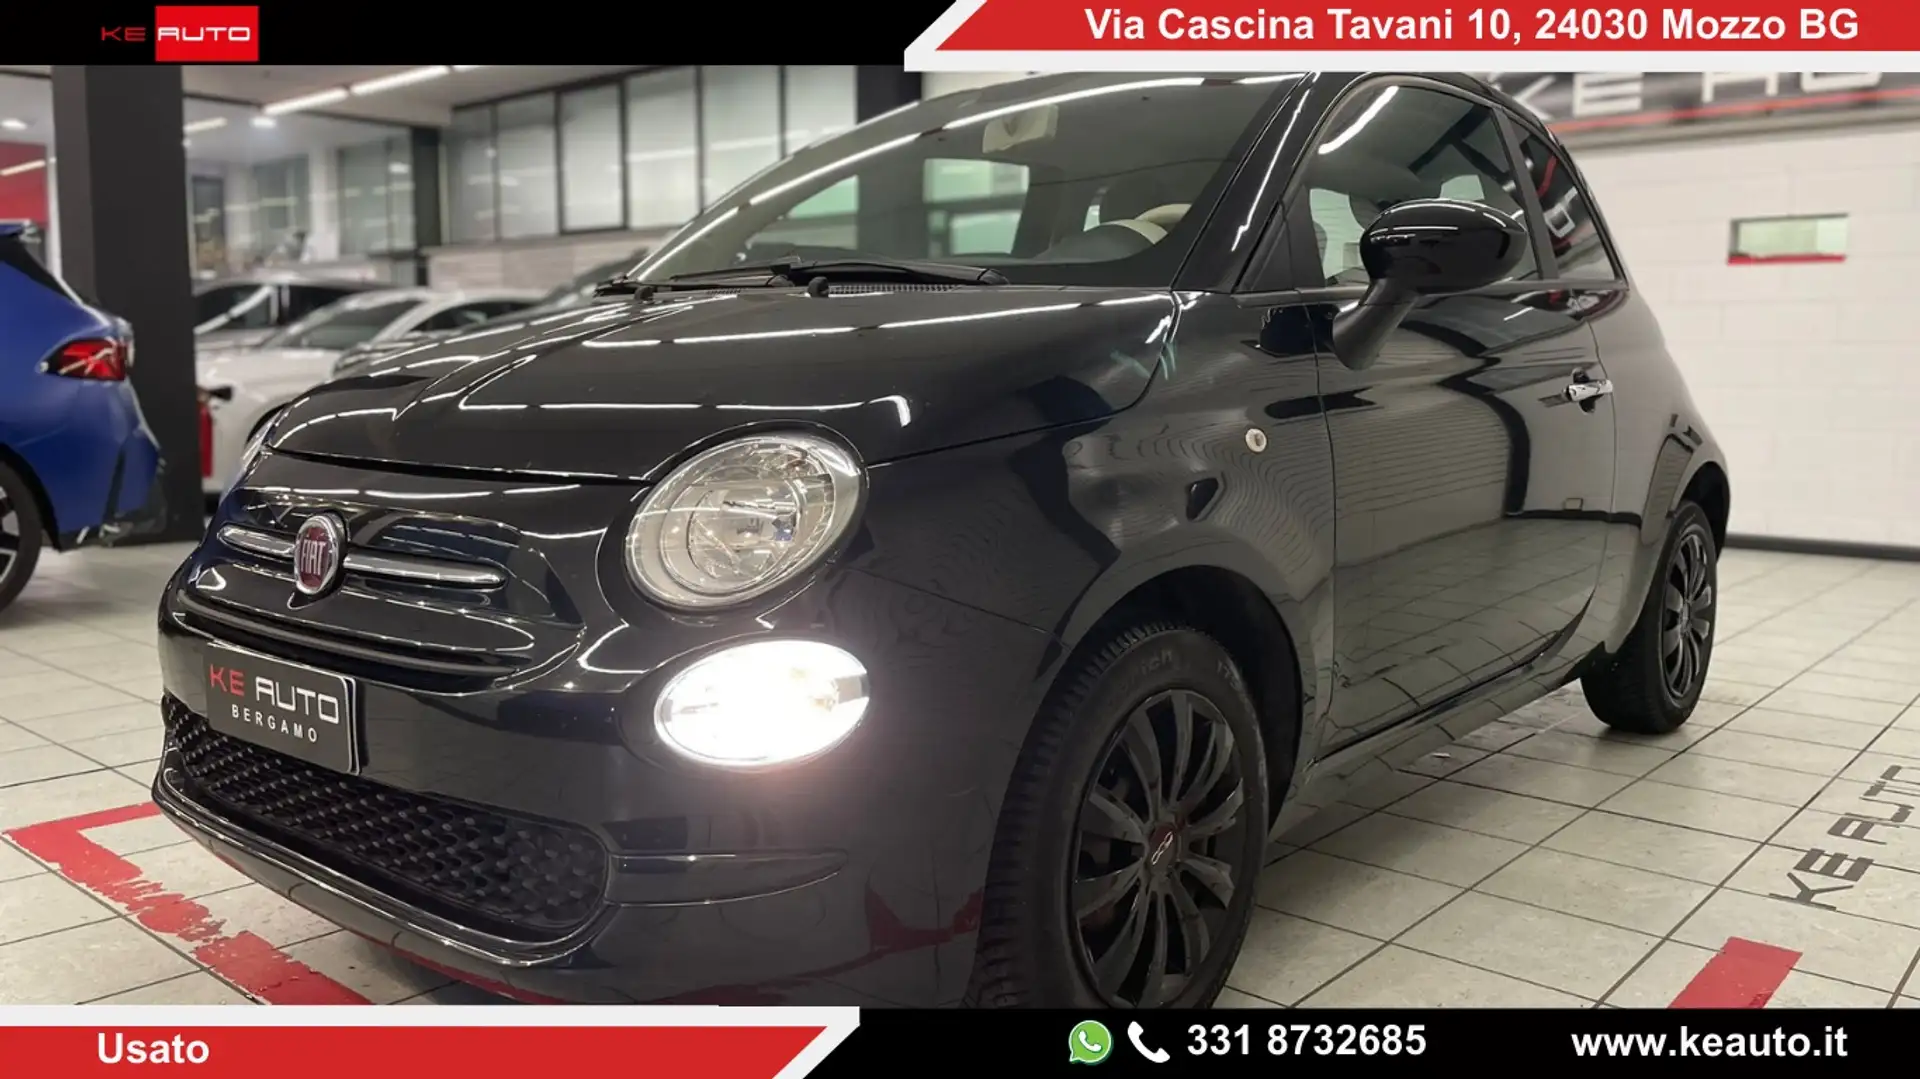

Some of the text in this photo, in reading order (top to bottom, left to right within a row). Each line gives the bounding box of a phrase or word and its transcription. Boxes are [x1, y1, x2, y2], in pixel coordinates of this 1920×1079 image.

[301, 539, 327, 575] FIAT
[209, 664, 340, 724] KE AUTO
[231, 703, 318, 742] BERGAMO
[1768, 847, 1874, 911] KE
